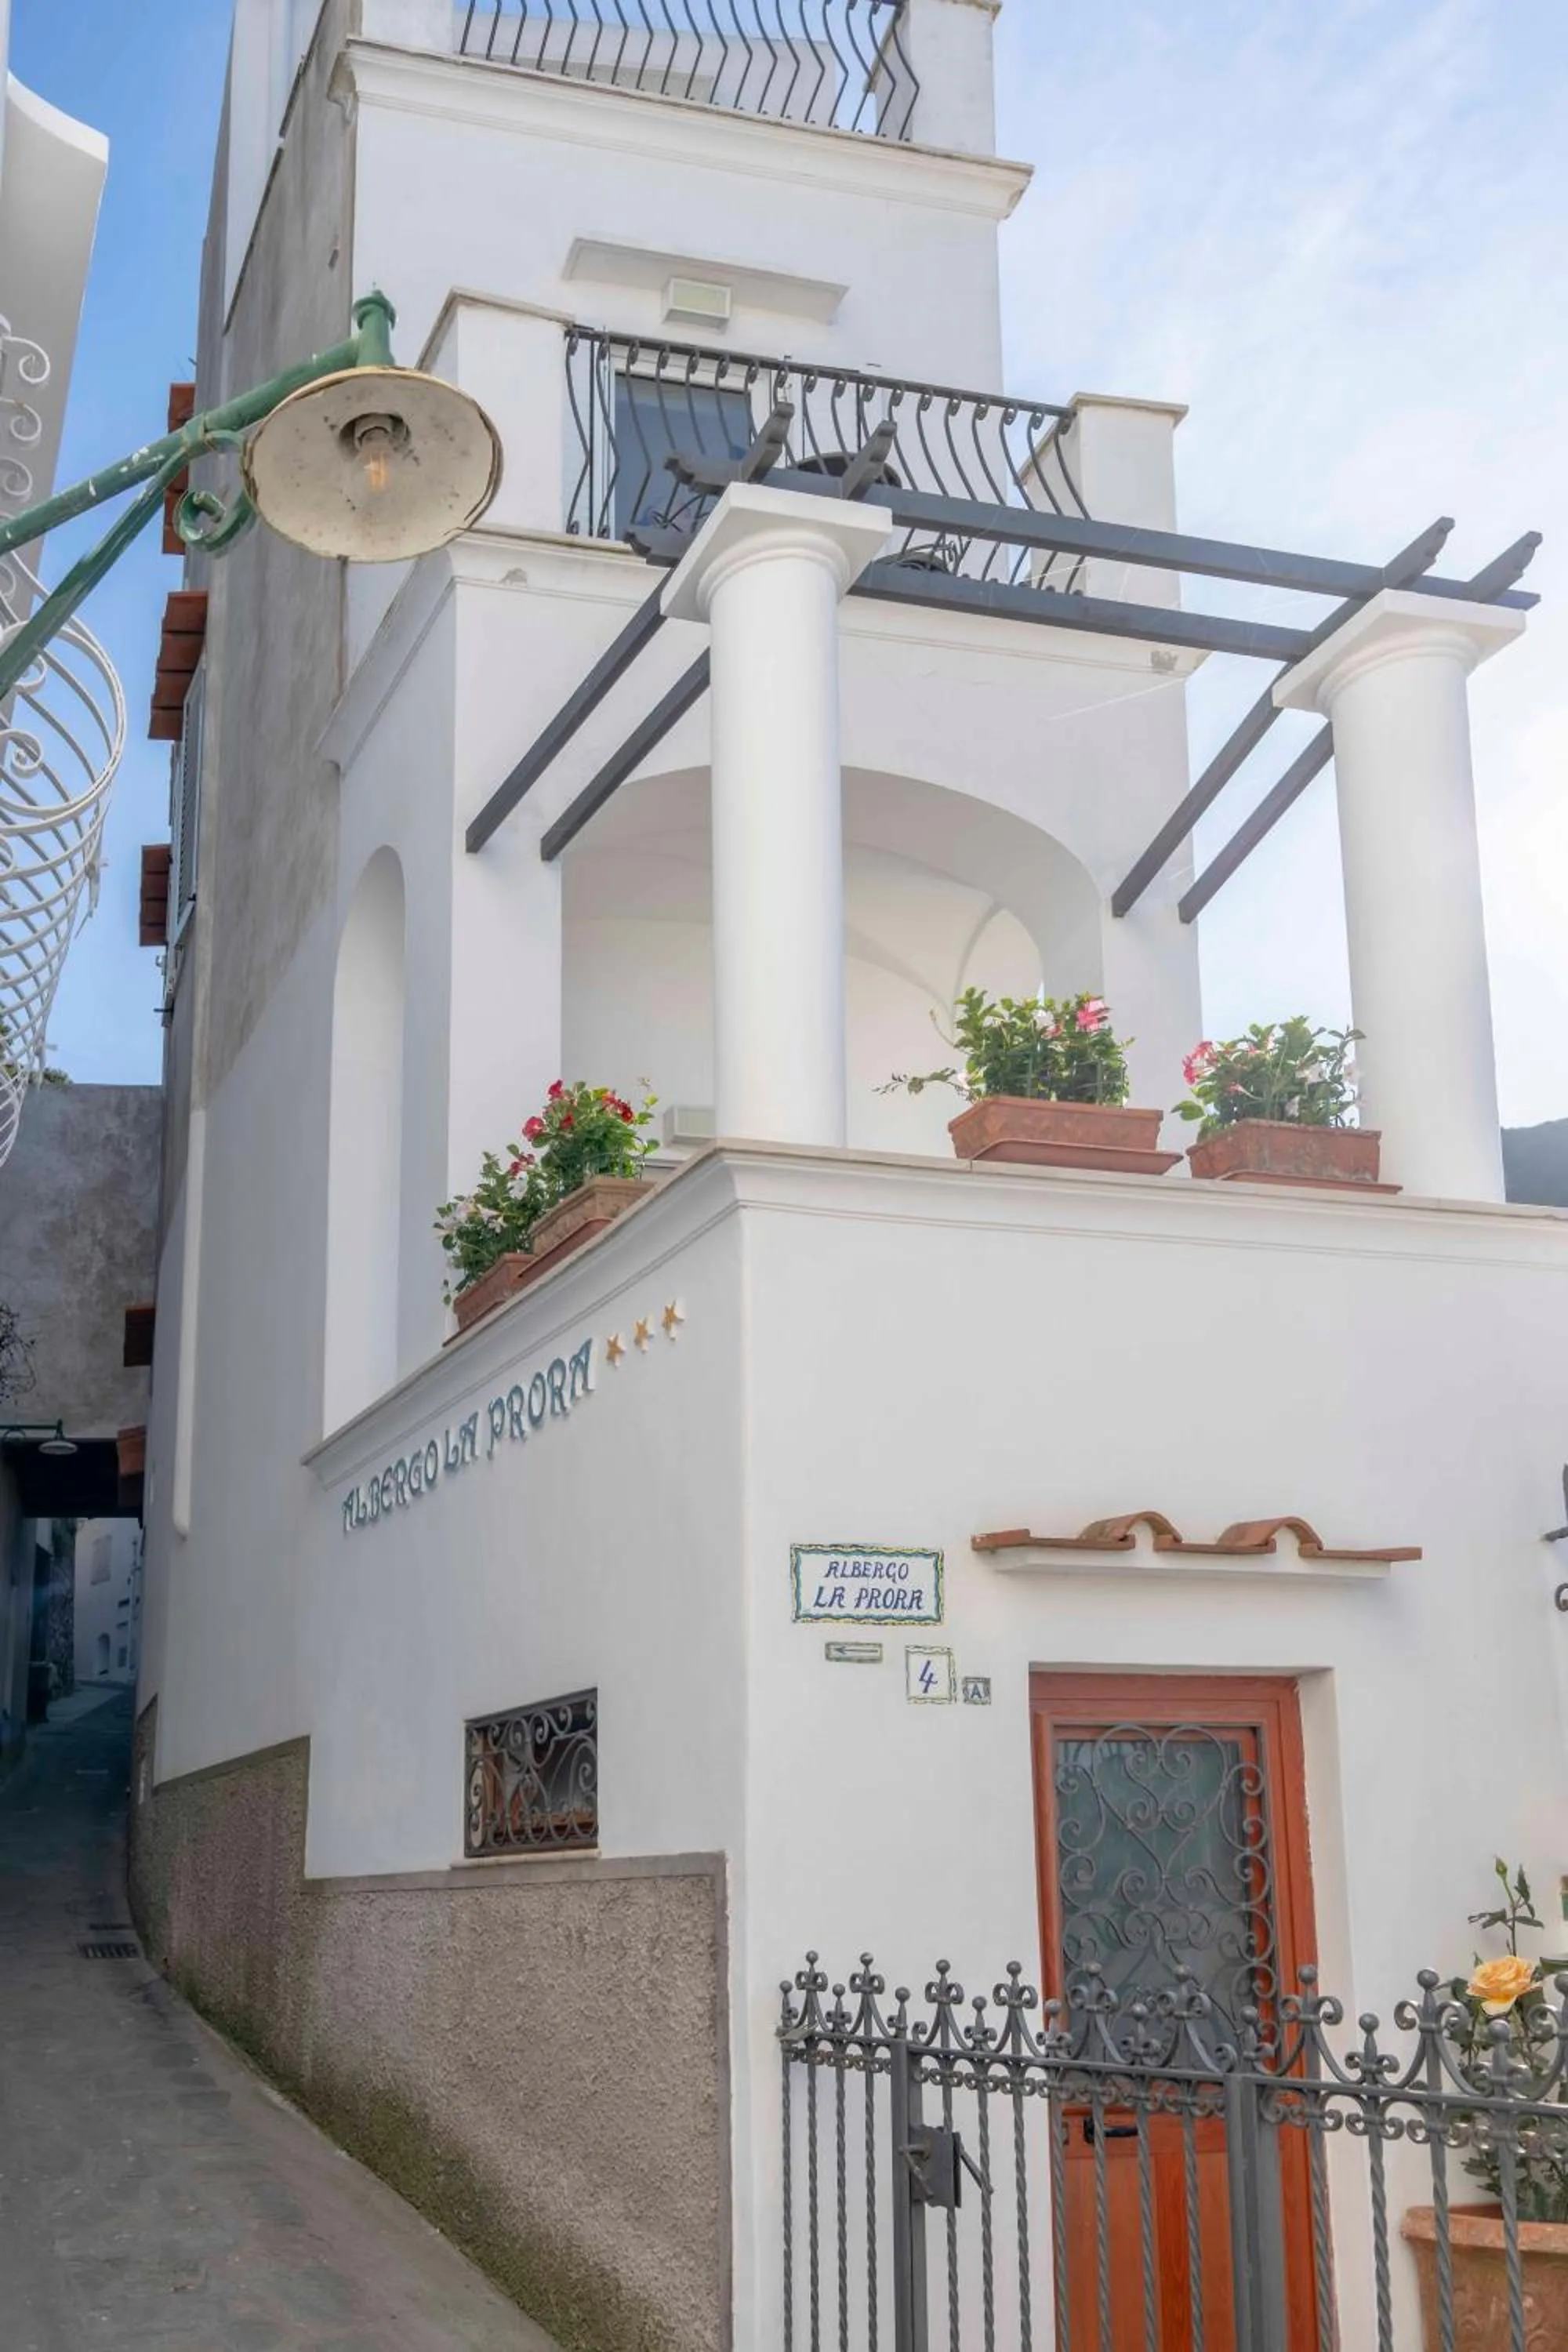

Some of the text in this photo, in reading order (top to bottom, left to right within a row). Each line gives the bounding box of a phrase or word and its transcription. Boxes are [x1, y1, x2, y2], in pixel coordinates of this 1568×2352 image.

[342, 1338, 593, 1534] ALBERGO LA PRORA
[824, 1560, 909, 1584] ALBERGO
[813, 1585, 924, 1610] LA PRORA
[918, 1659, 938, 1694] 4
[969, 1684, 982, 1699] A
